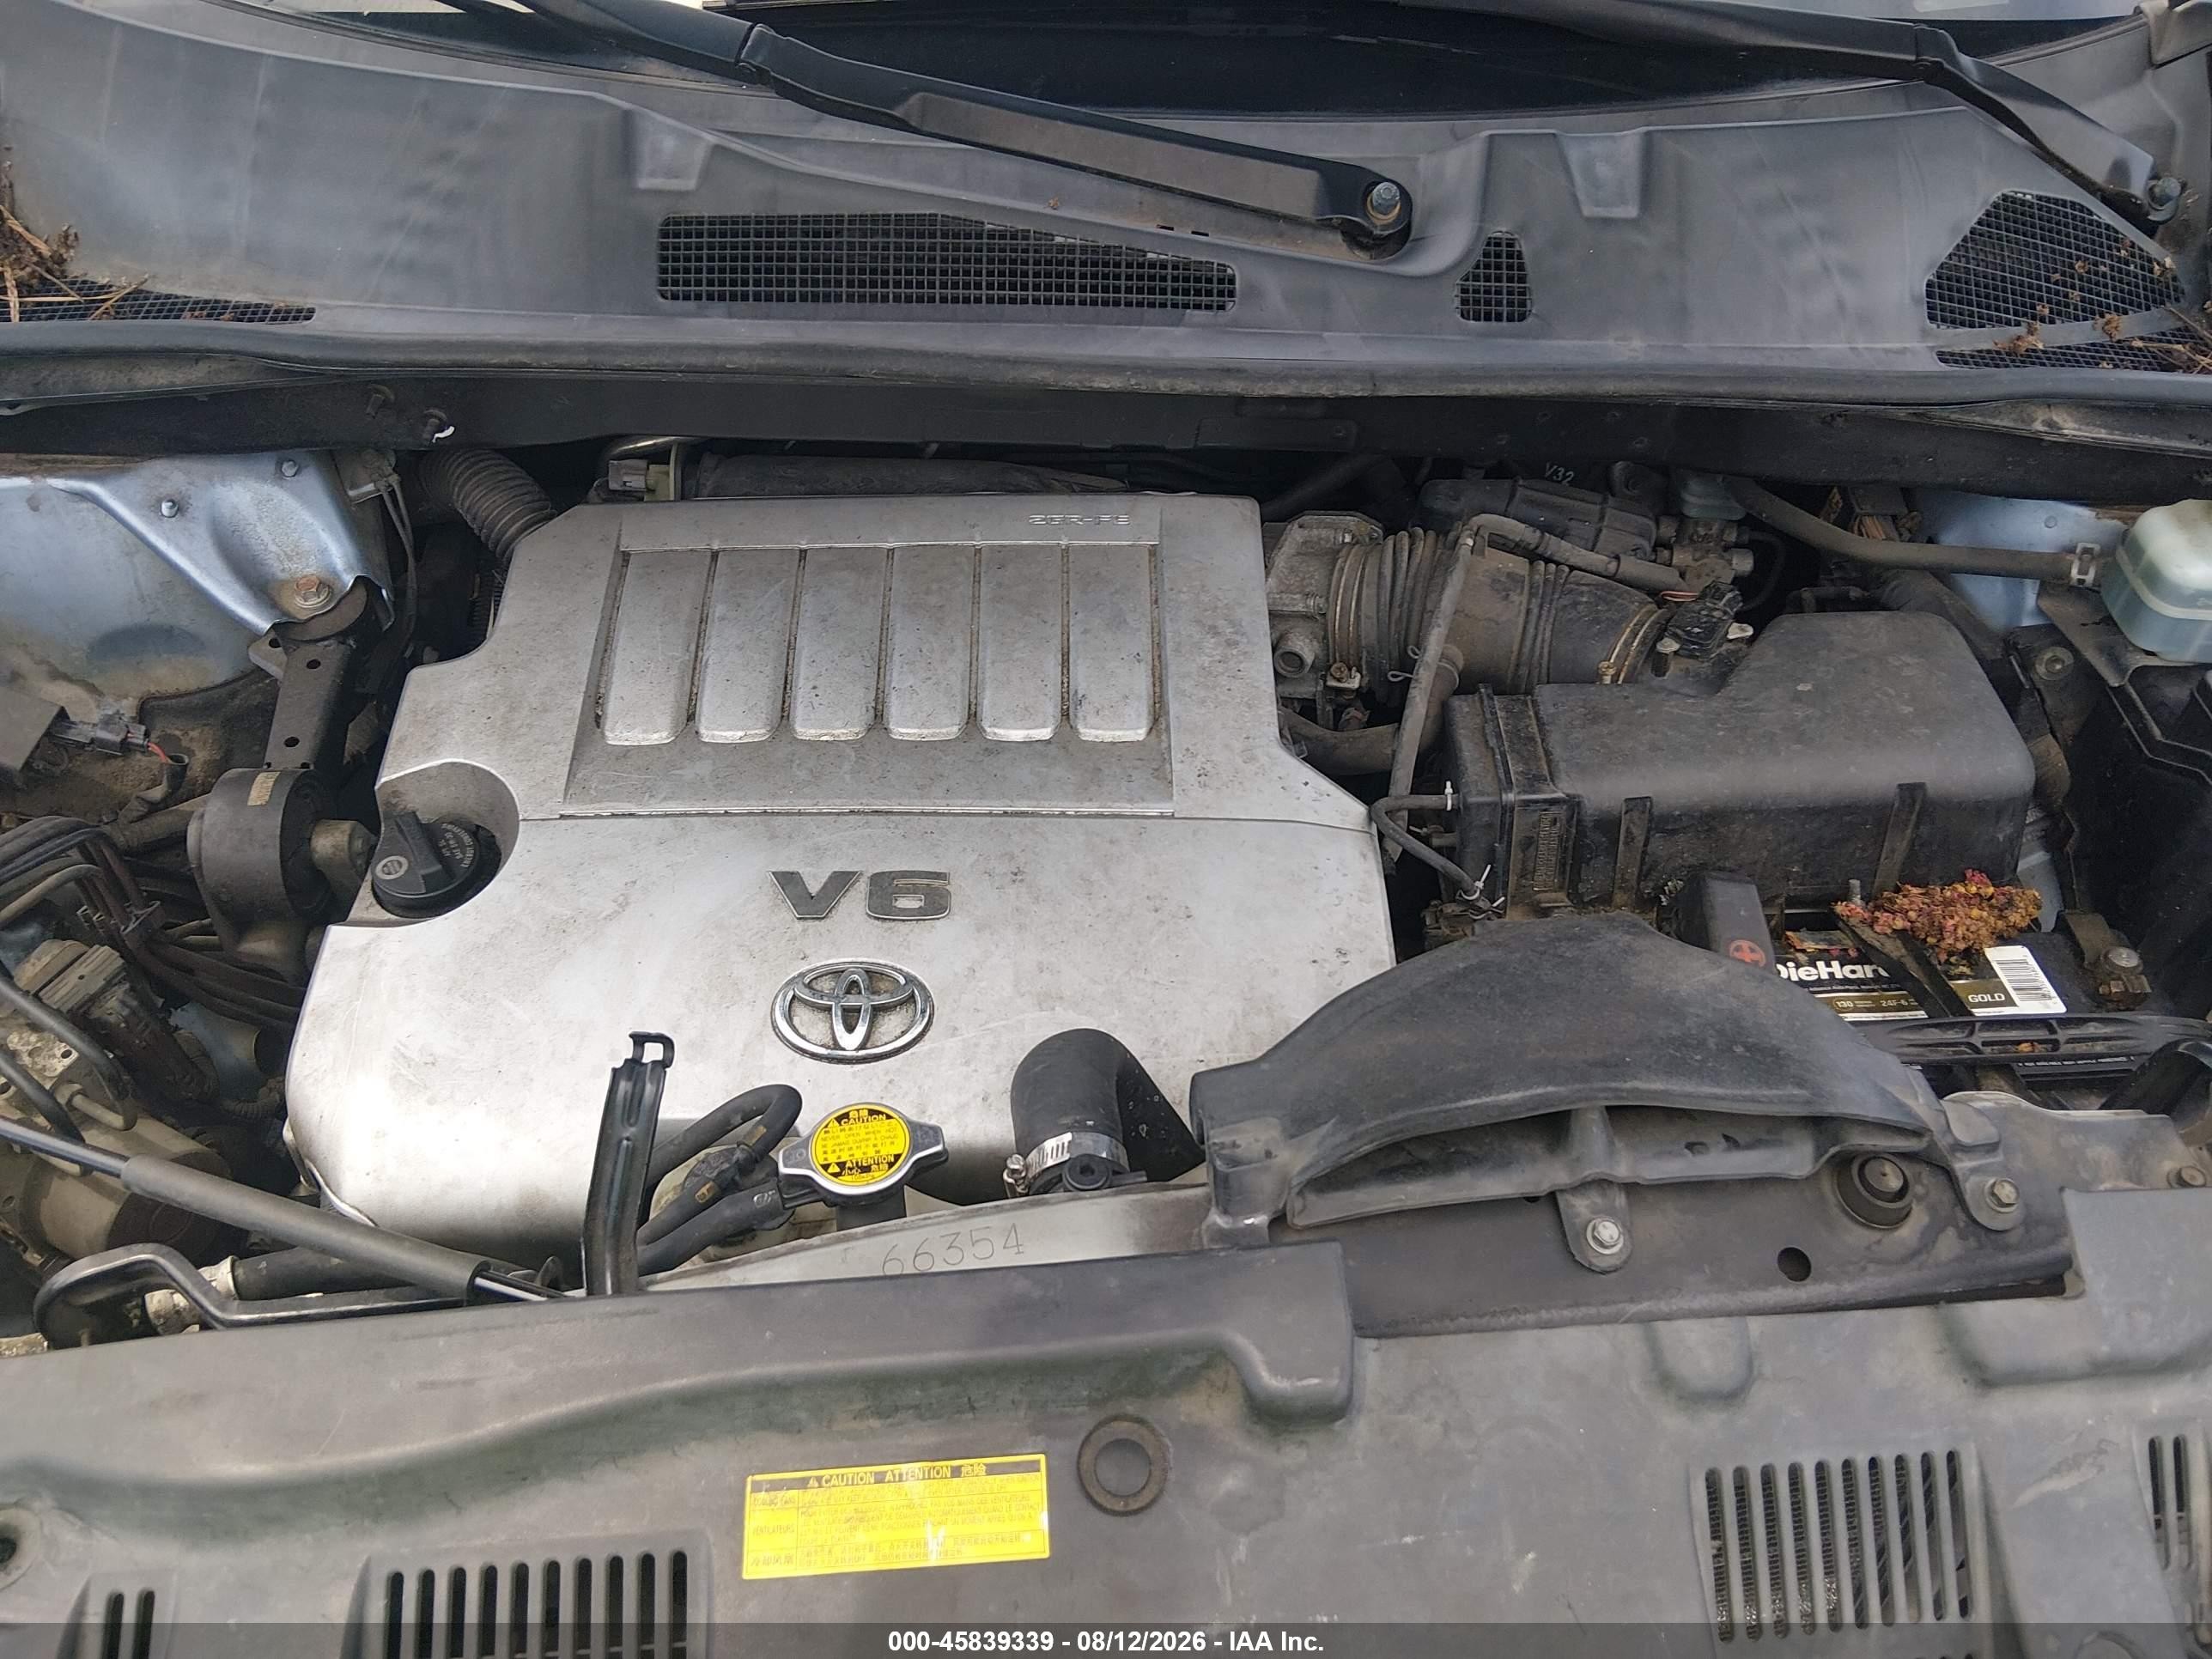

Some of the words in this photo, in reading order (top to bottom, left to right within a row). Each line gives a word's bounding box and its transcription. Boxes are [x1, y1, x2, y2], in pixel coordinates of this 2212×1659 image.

[768, 871, 951, 920] V6
[1968, 993, 2005, 1003] GOLD
[841, 1114, 886, 1126] CAUTION
[845, 1155, 895, 1168] ATTENTION
[881, 1222, 1024, 1276] 66354
[823, 1472, 875, 1486] CAUTION
[884, 1465, 951, 1482] ATTENTION
